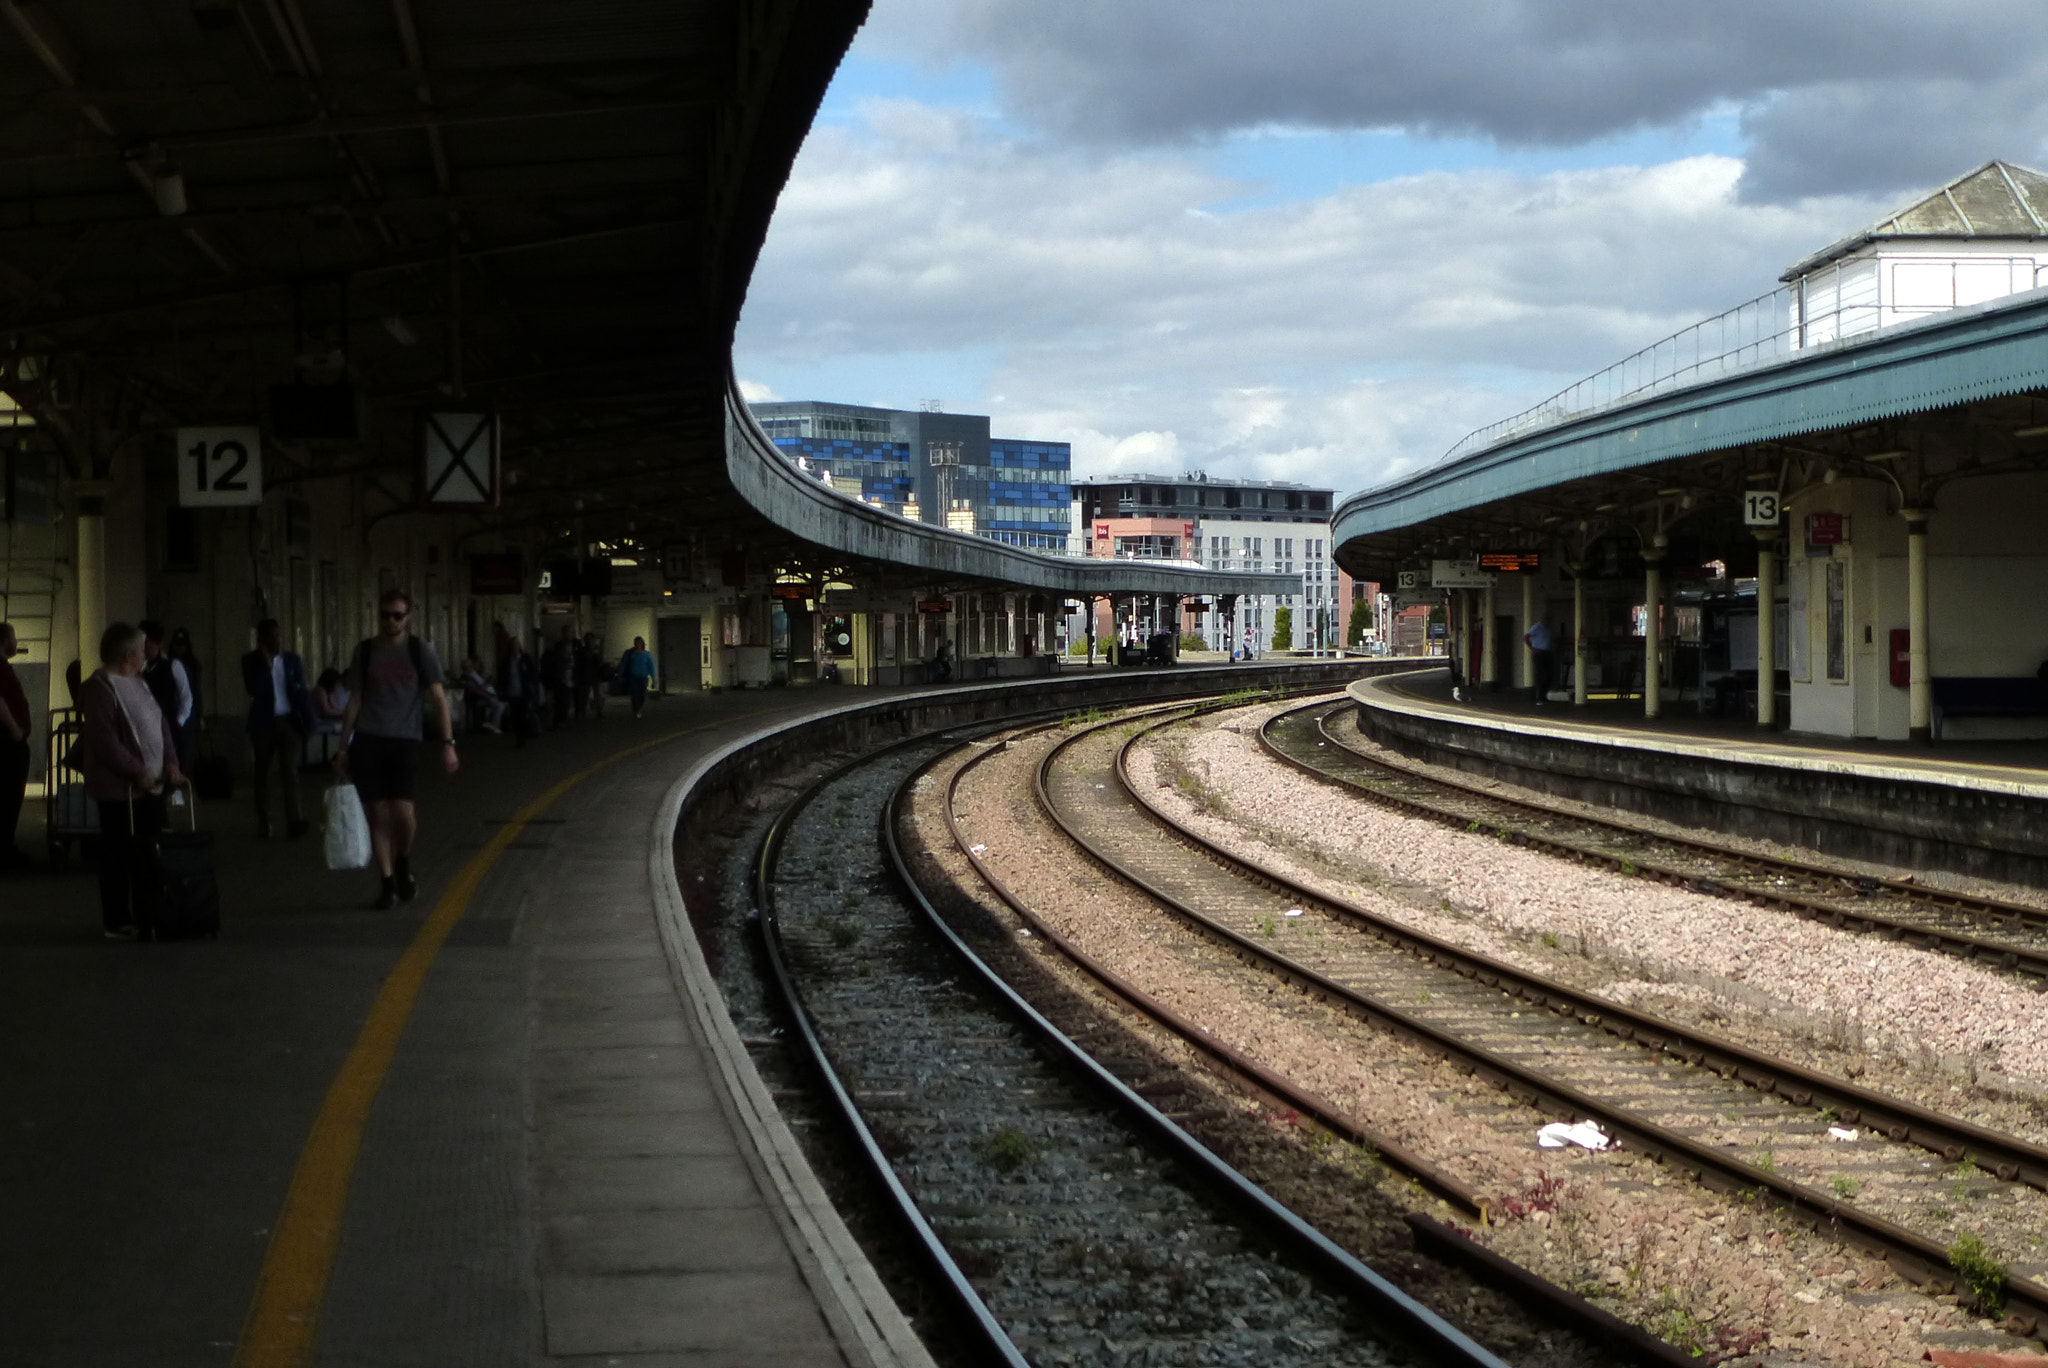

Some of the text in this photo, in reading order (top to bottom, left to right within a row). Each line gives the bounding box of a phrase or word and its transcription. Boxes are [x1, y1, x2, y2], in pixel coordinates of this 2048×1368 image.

[189, 440, 247, 491] 12
[1748, 496, 1777, 520] 13
[1400, 573, 1415, 586] 13
